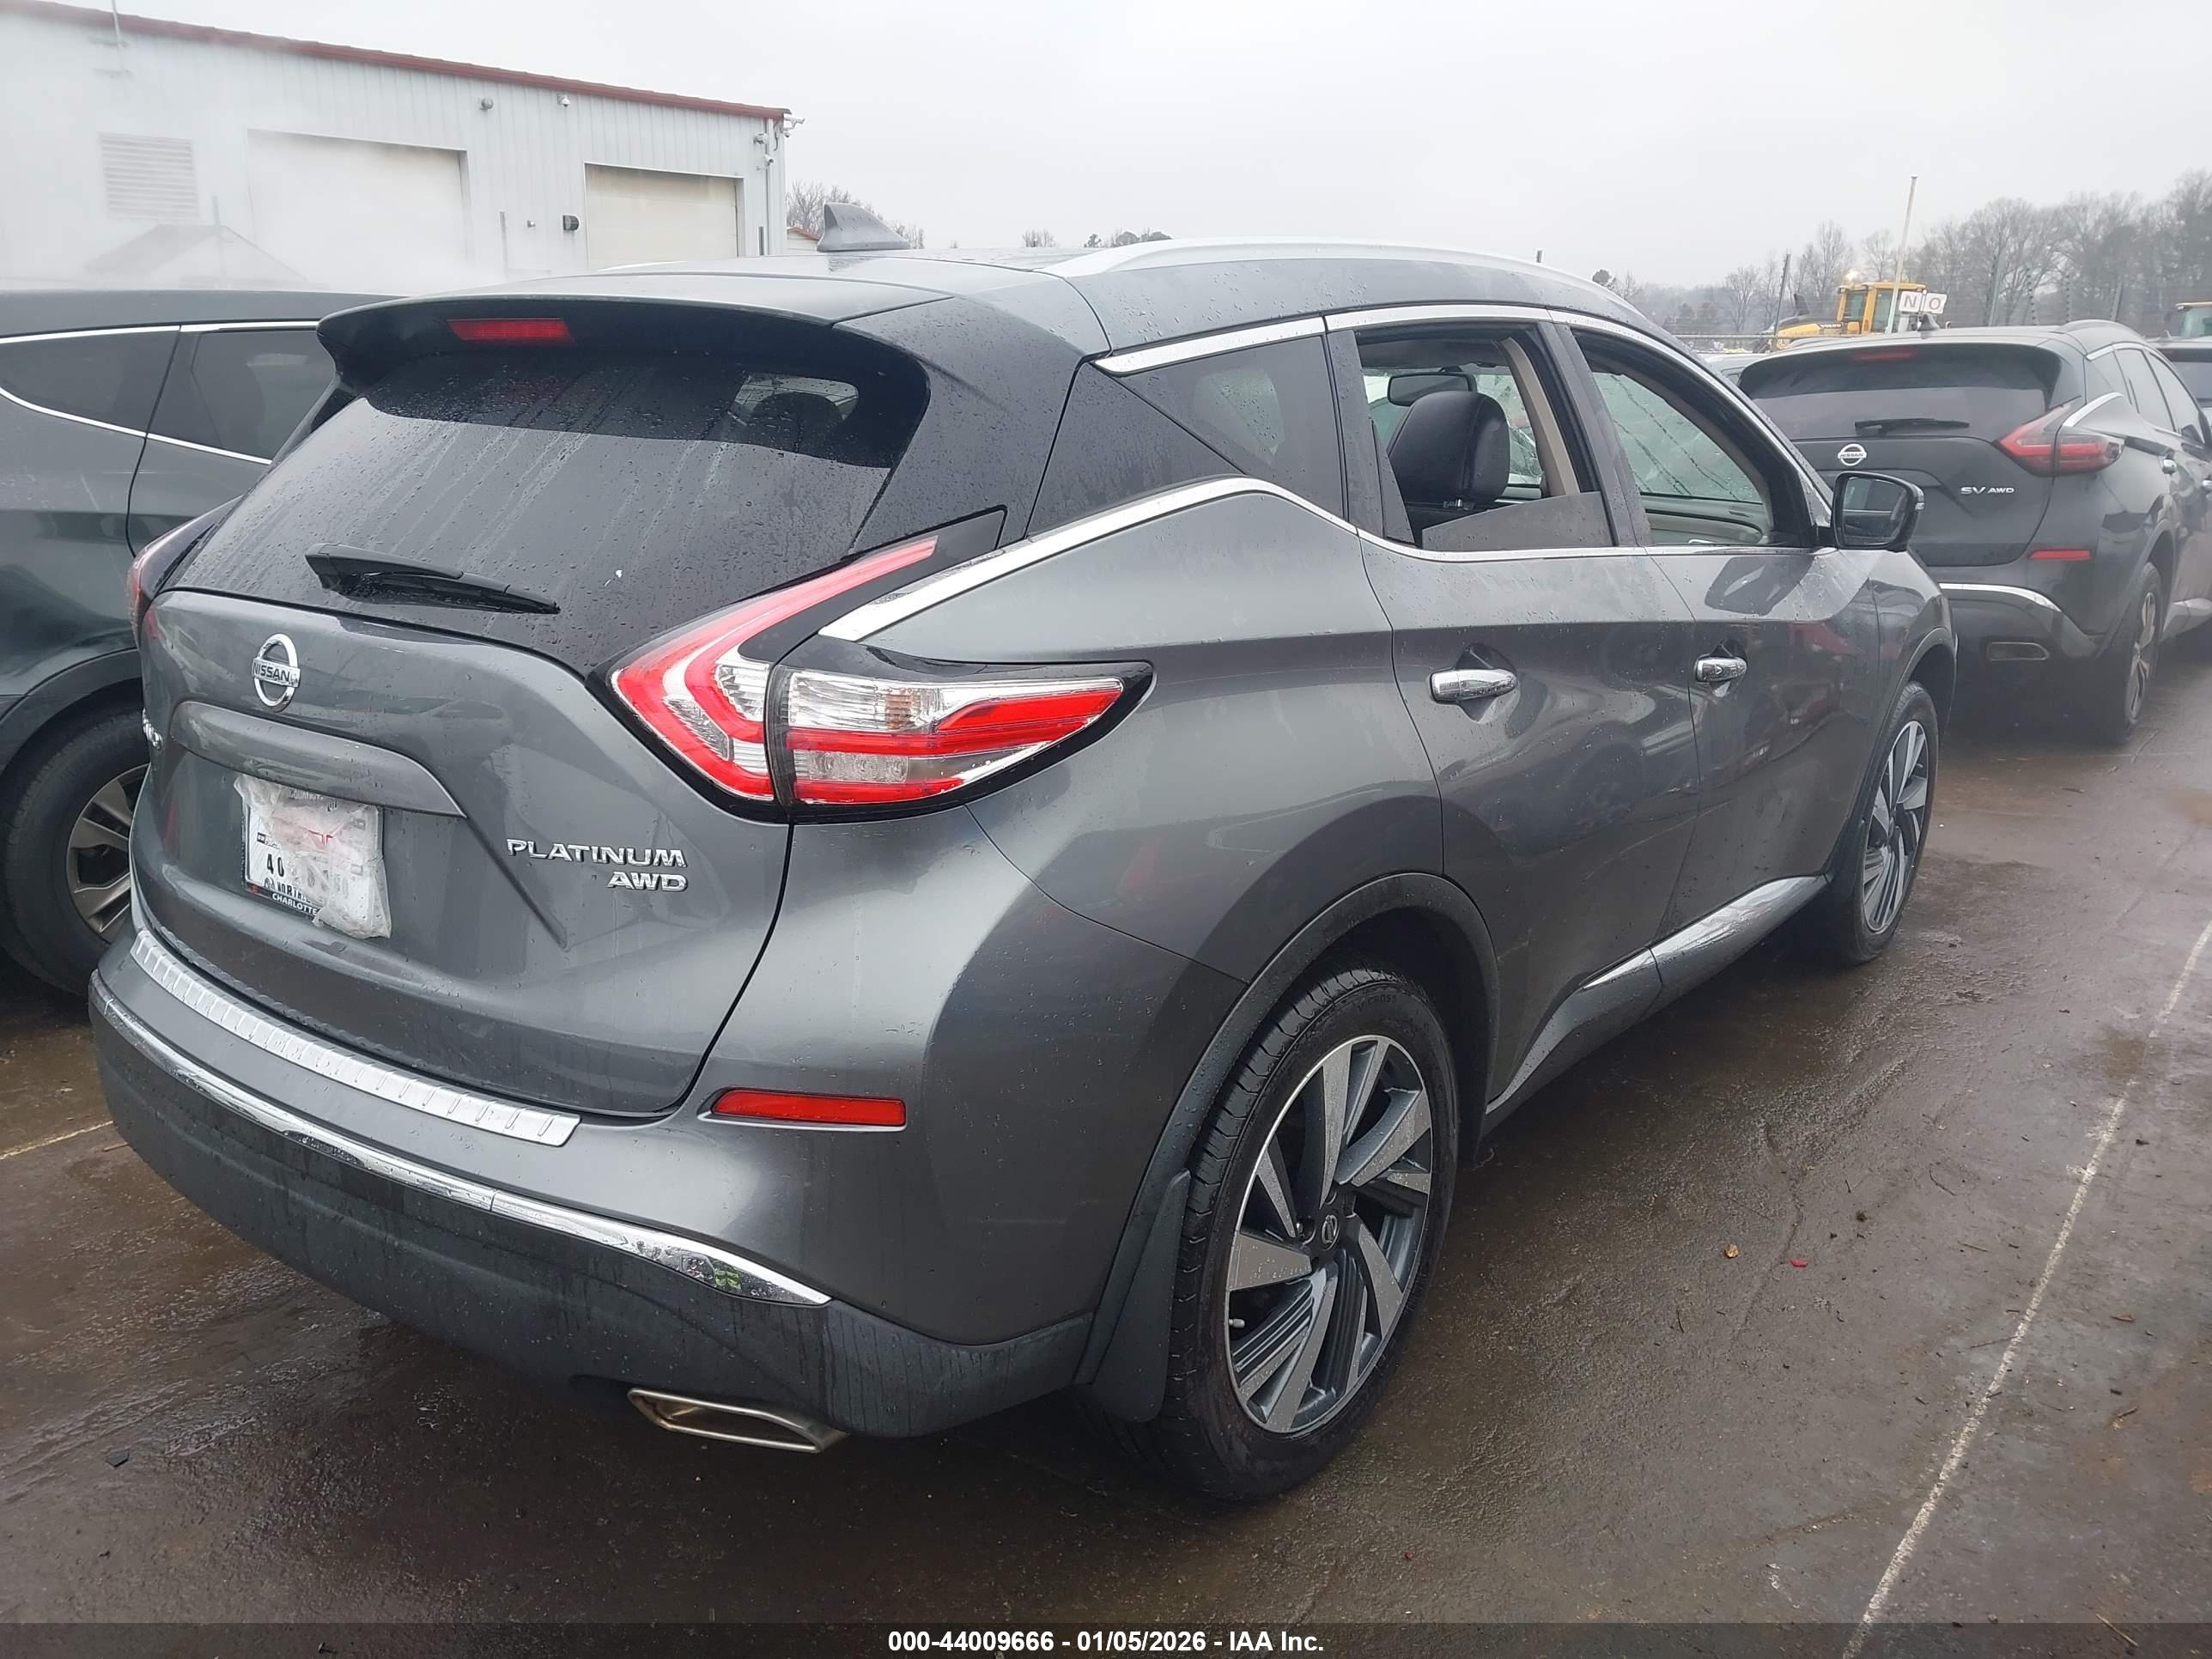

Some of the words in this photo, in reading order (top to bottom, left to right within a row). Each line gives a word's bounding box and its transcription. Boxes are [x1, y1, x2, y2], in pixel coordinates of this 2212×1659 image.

[1960, 486, 1986, 495] SV
[253, 661, 290, 682] NISSAN
[506, 838, 688, 868] PLATINUM
[606, 871, 688, 892] AWD
[272, 892, 319, 916] CHARLOTTE
